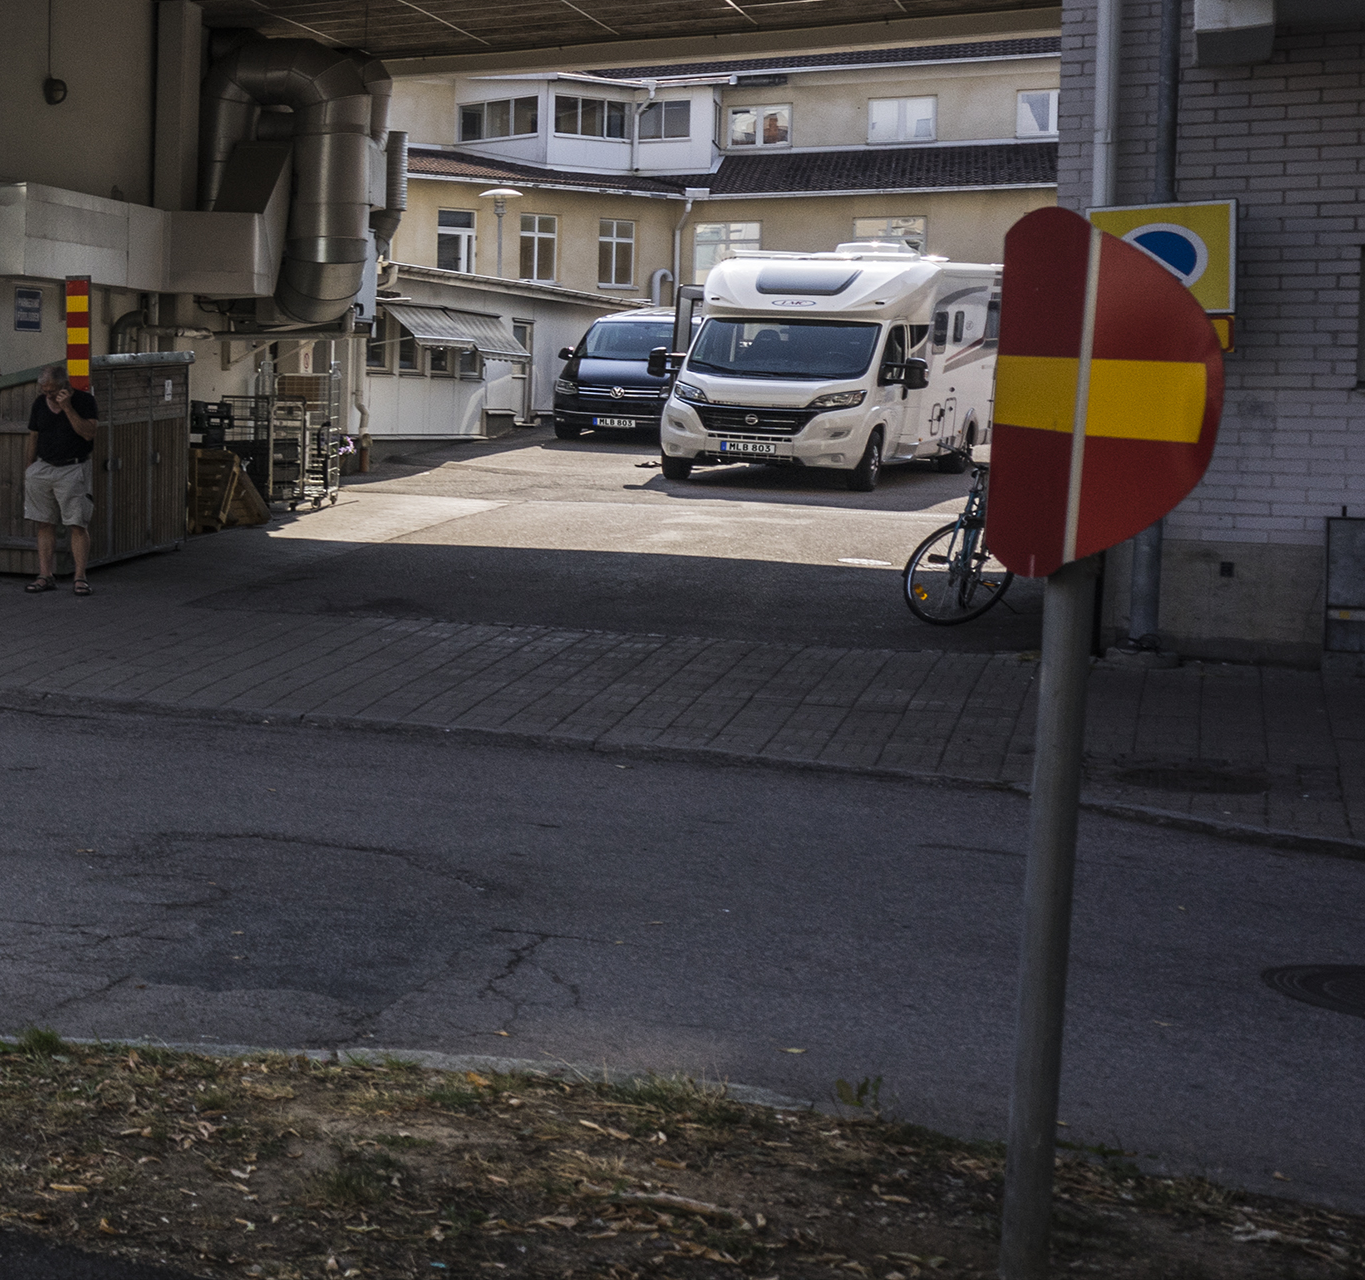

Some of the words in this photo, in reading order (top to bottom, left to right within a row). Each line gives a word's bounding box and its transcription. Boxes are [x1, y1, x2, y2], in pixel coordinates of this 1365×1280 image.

[617, 419, 633, 427] 803
[729, 442, 749, 451] MLB
[751, 444, 771, 453] 803
